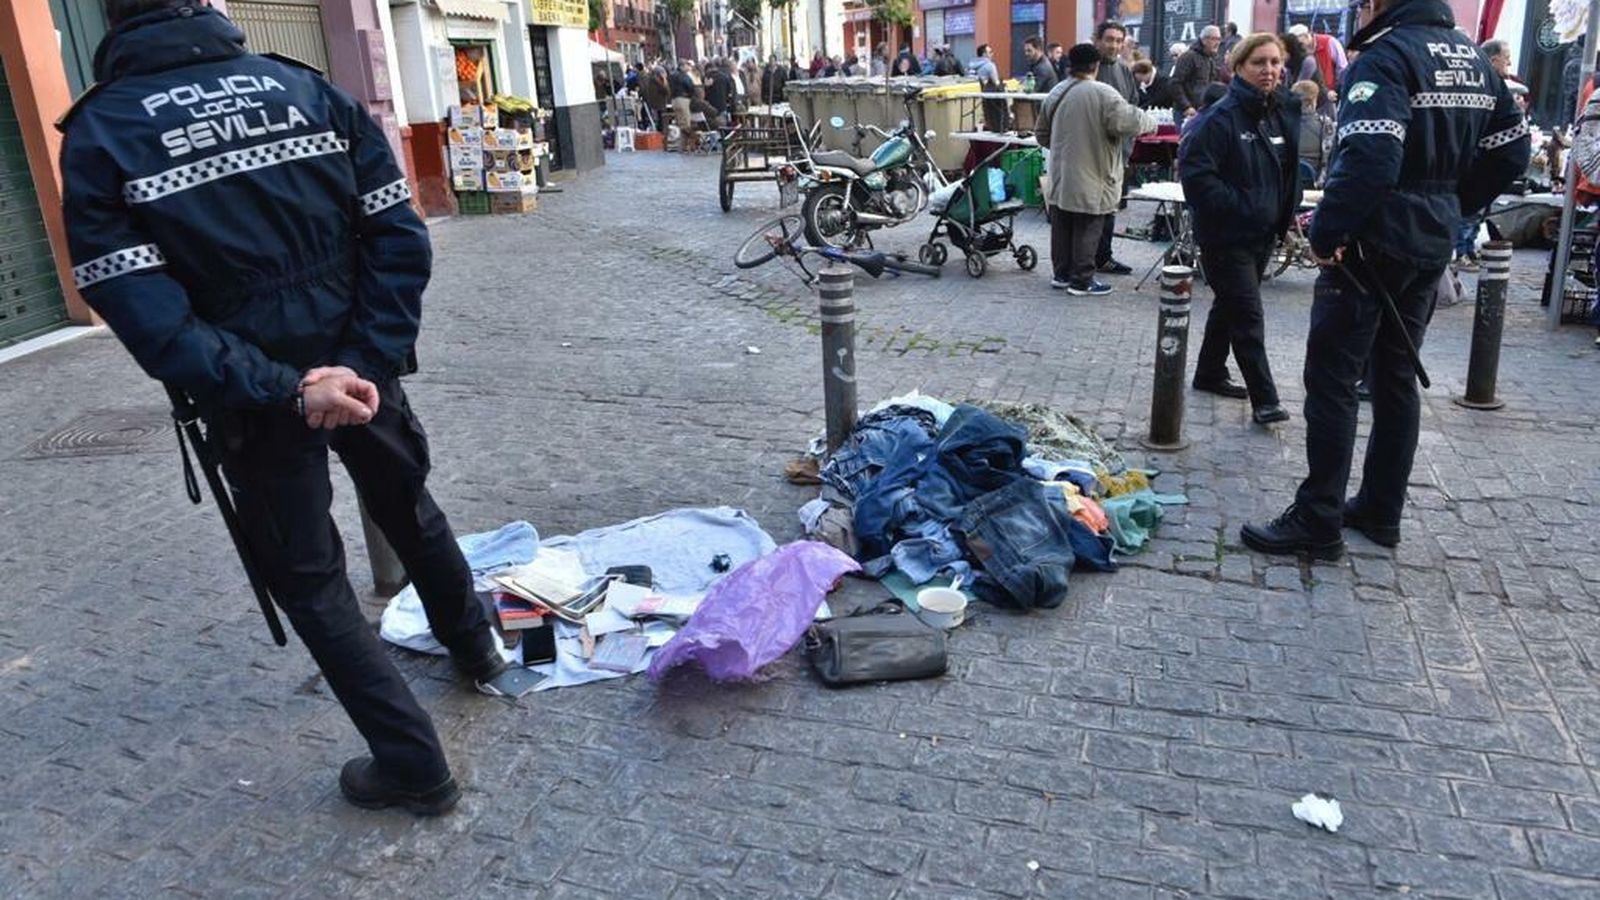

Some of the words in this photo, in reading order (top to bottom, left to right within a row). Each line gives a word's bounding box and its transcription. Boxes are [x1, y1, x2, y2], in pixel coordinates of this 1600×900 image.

[1427, 42, 1479, 59] POLICIA
[1446, 59, 1472, 69] LOCAL
[1435, 70, 1485, 87] SEVILLA
[141, 75, 286, 116] POLICIA
[188, 96, 263, 118] LOCAL
[161, 105, 309, 157] SEVILLA
